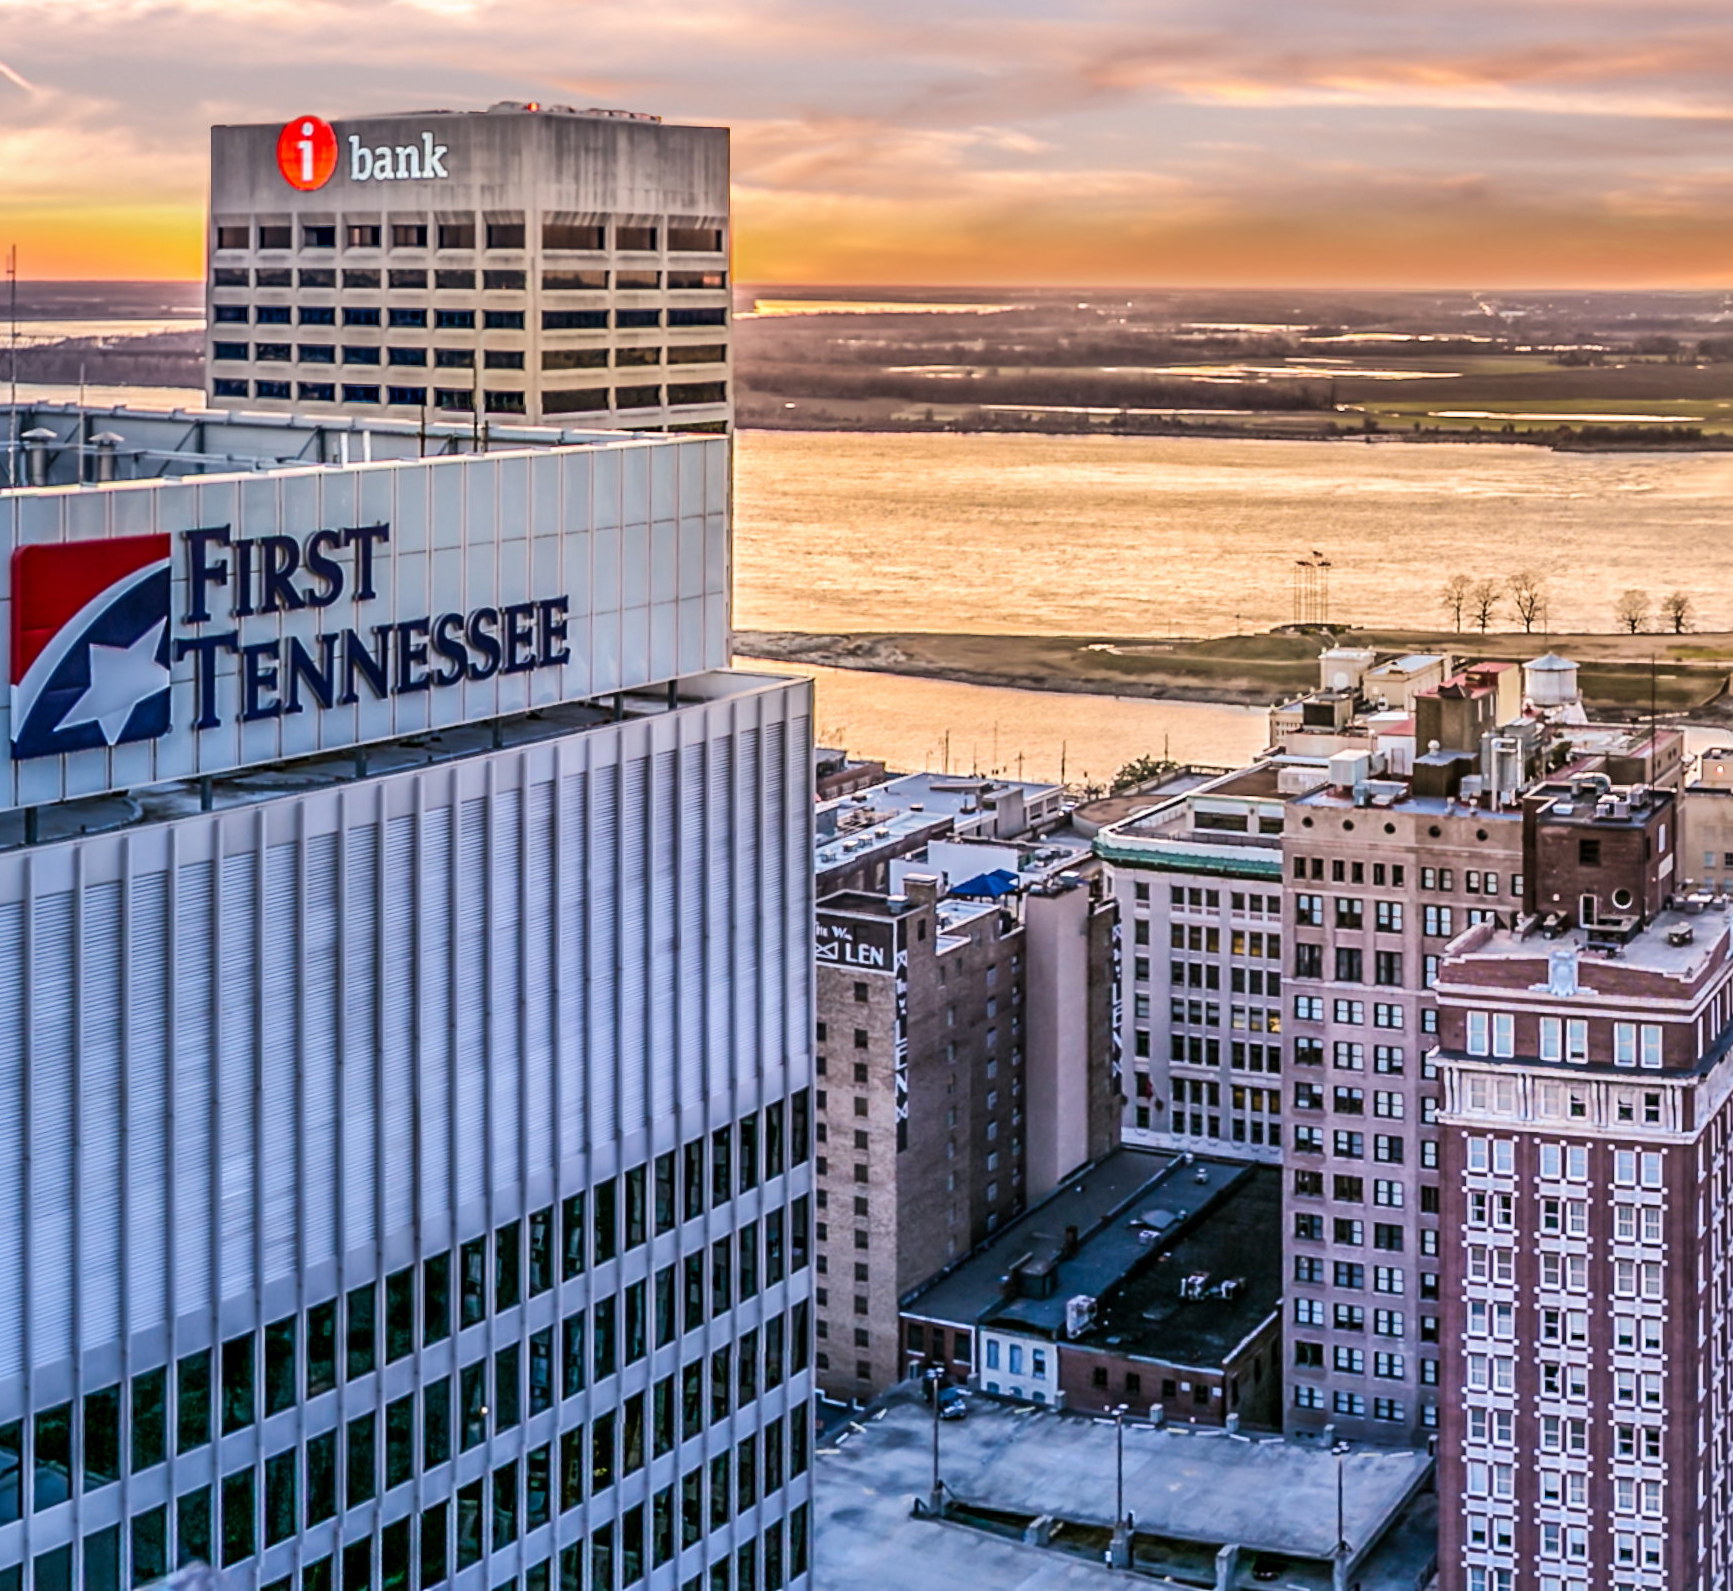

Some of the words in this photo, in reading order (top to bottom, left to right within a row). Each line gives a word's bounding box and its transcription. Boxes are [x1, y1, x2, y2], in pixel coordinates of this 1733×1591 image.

[348, 131, 449, 181] bank
[180, 522, 390, 625] FIRST
[173, 595, 571, 731] TENNESSEE
[845, 943, 884, 967] LEN
